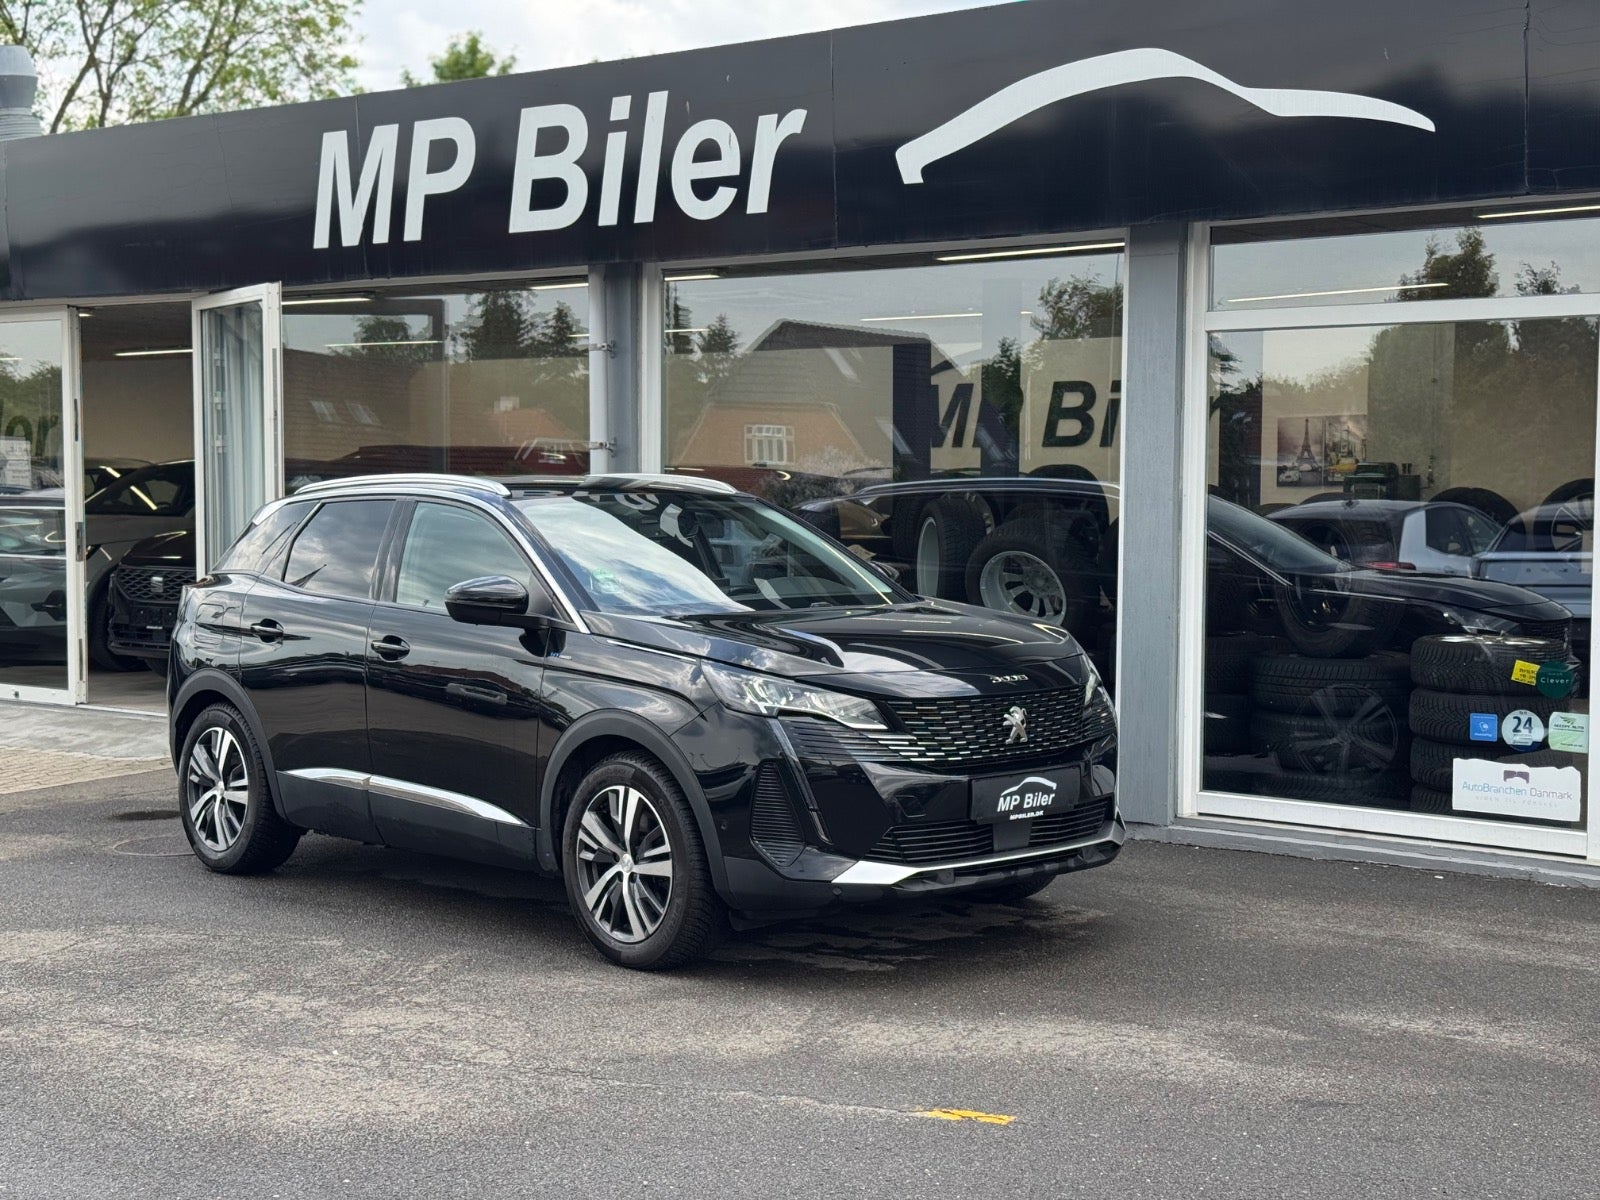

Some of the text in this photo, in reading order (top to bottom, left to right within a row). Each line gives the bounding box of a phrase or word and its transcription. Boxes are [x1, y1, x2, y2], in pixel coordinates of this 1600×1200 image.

[313, 90, 808, 249] MP Biler
[1540, 676, 1570, 684] Clever
[1512, 715, 1534, 734] 24
[1462, 781, 1573, 801] AutoBranchen Danmark
[997, 791, 1056, 812] MP Biler
